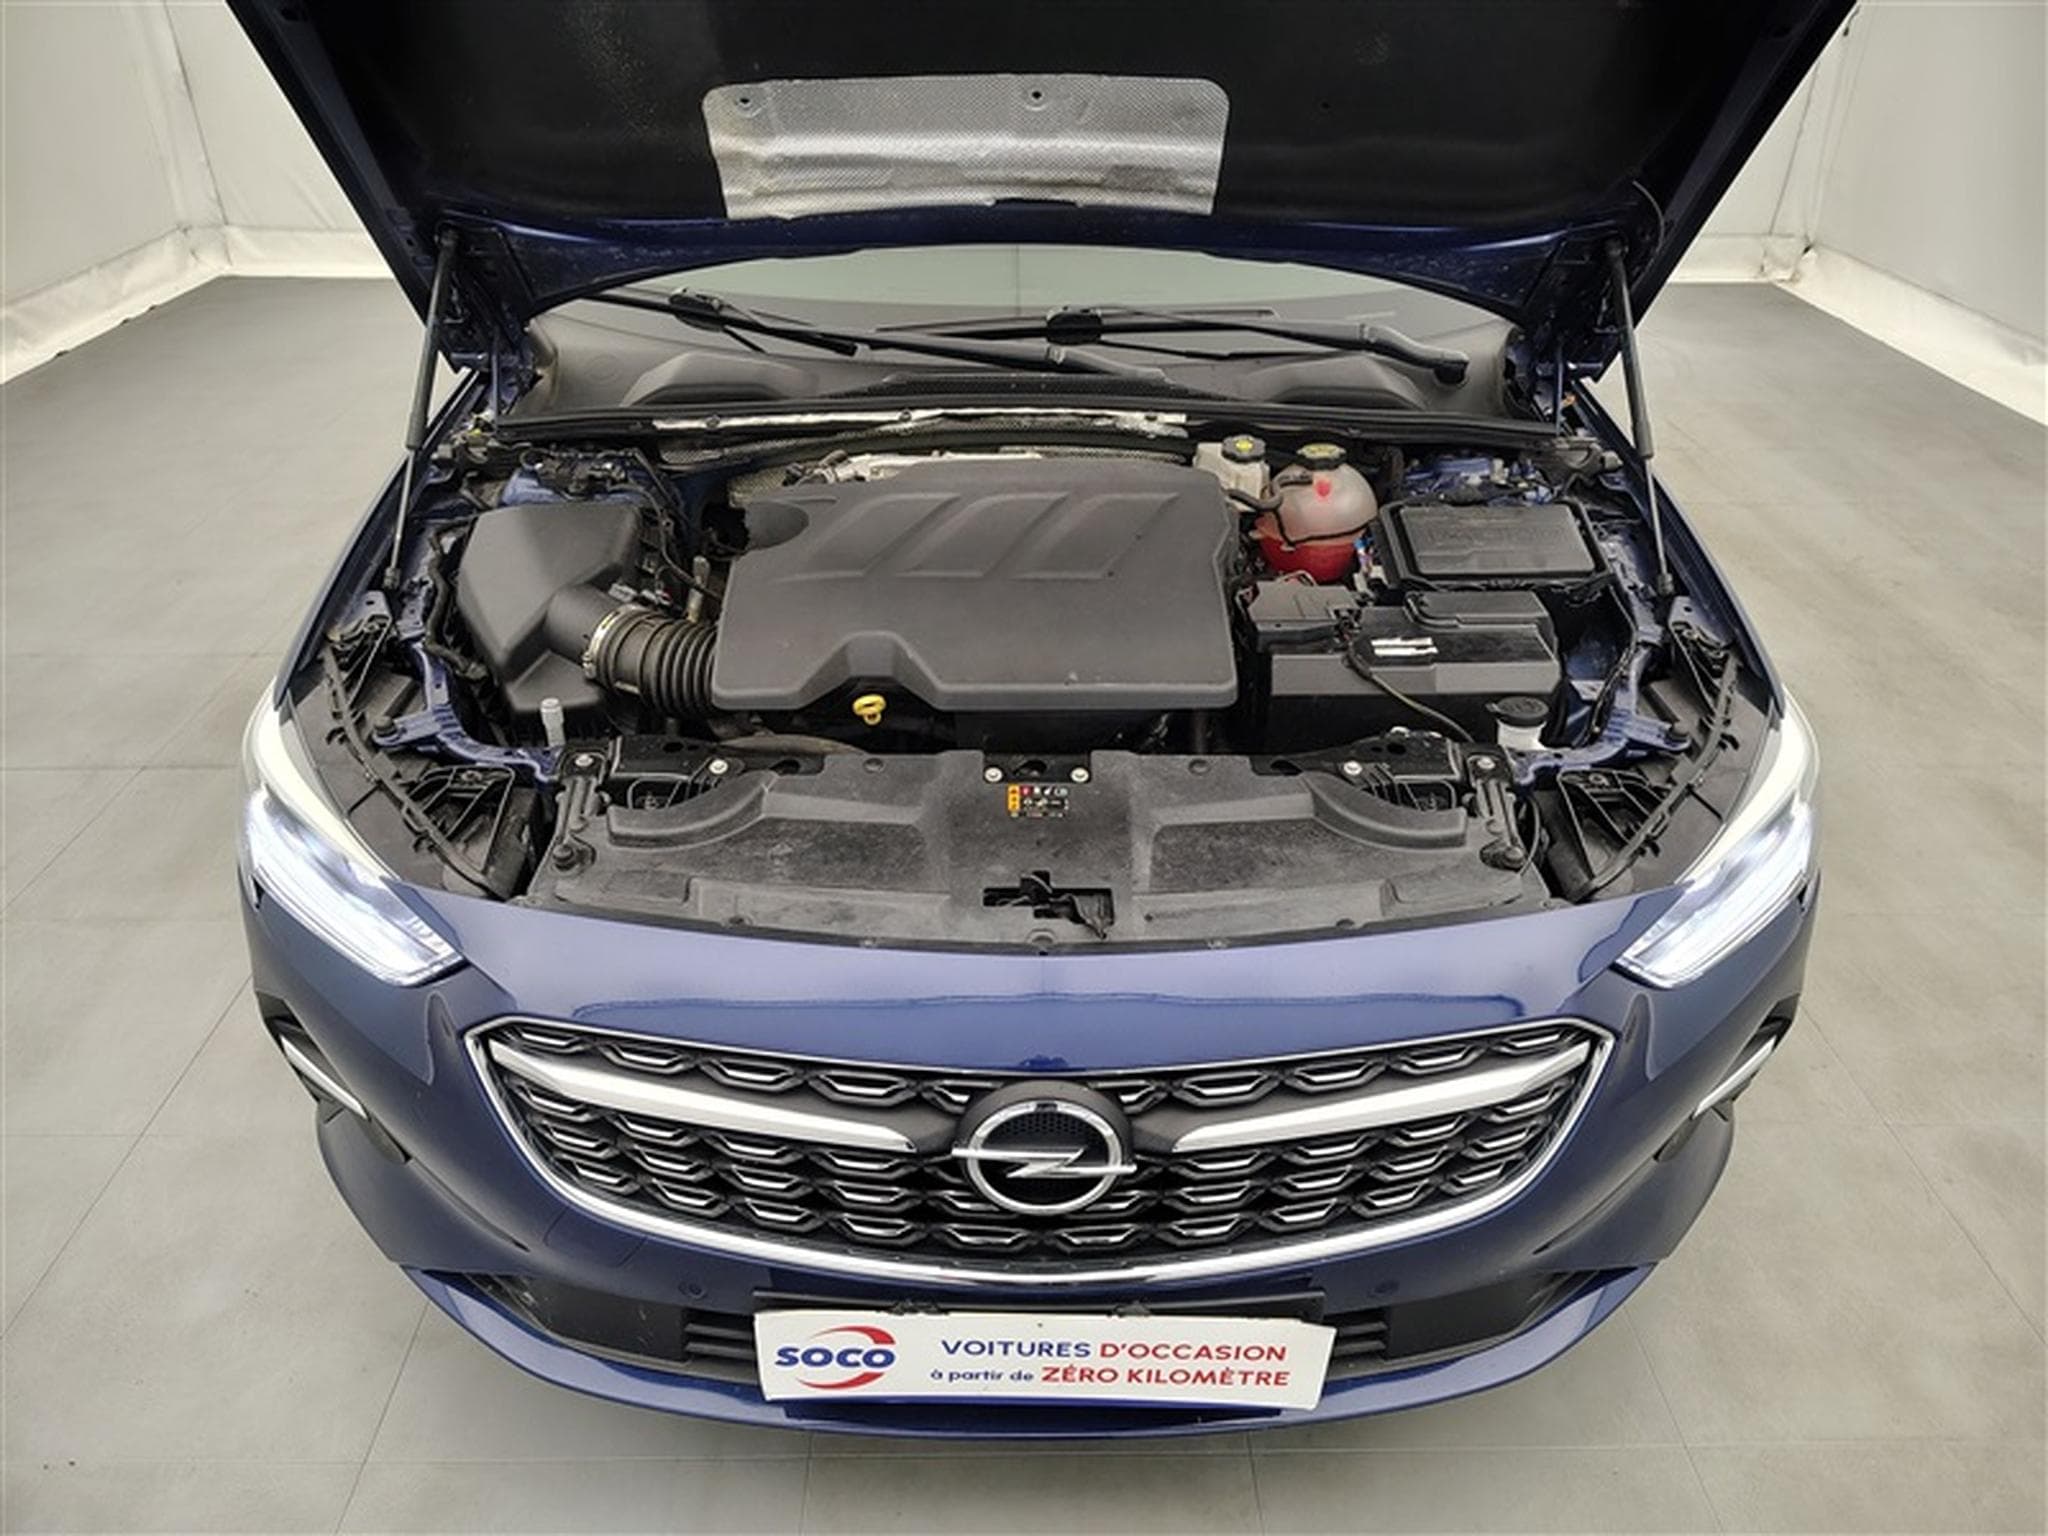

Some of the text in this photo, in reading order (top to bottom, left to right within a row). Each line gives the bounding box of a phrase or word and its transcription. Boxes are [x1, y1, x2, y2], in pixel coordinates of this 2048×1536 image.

[775, 1347, 896, 1368] SOCO
[941, 1340, 1287, 1361] VOITURES D'OCCASION
[930, 1364, 1290, 1386] à partir de ZÉRO KILOMÈTRE
